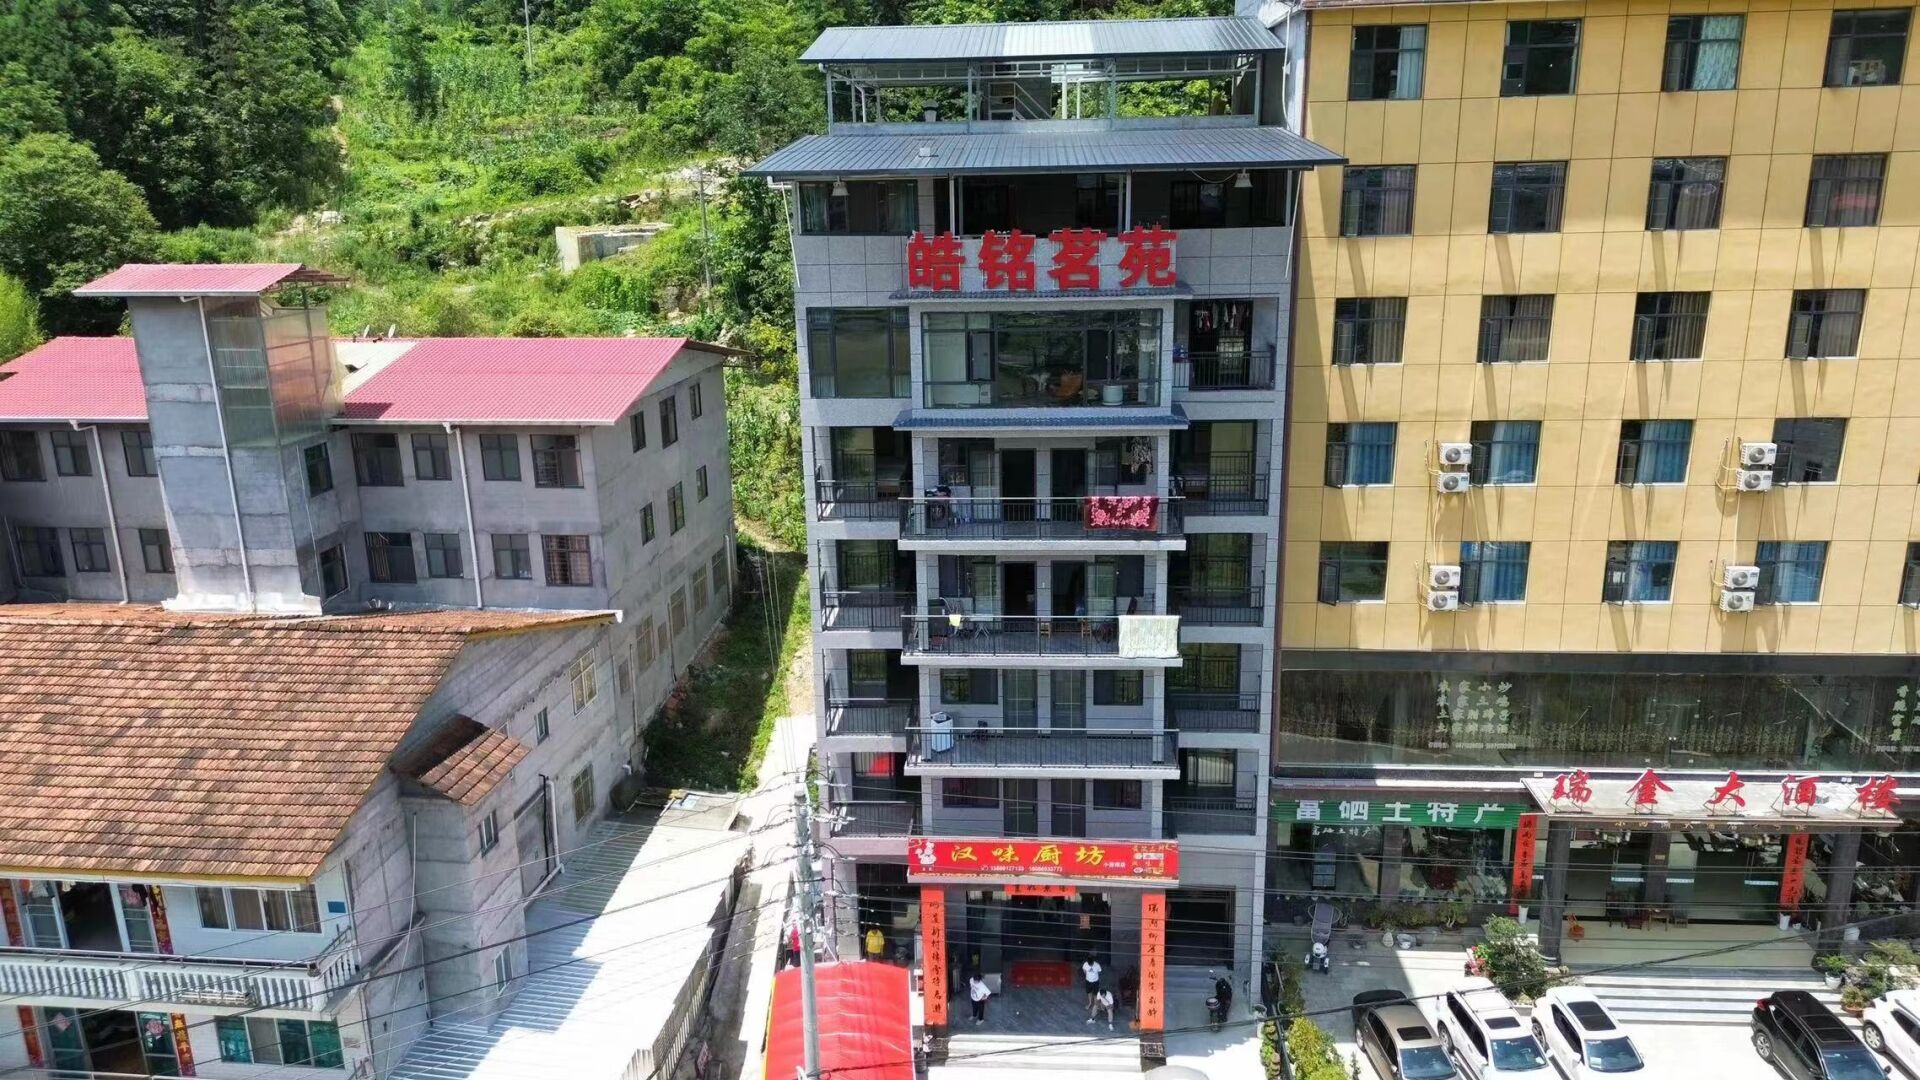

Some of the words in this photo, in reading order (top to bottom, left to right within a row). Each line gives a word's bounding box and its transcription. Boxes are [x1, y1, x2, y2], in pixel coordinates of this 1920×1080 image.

[908, 225, 1179, 292] 皓铭茗苑
[951, 844, 1106, 867] 汉味厨坊
